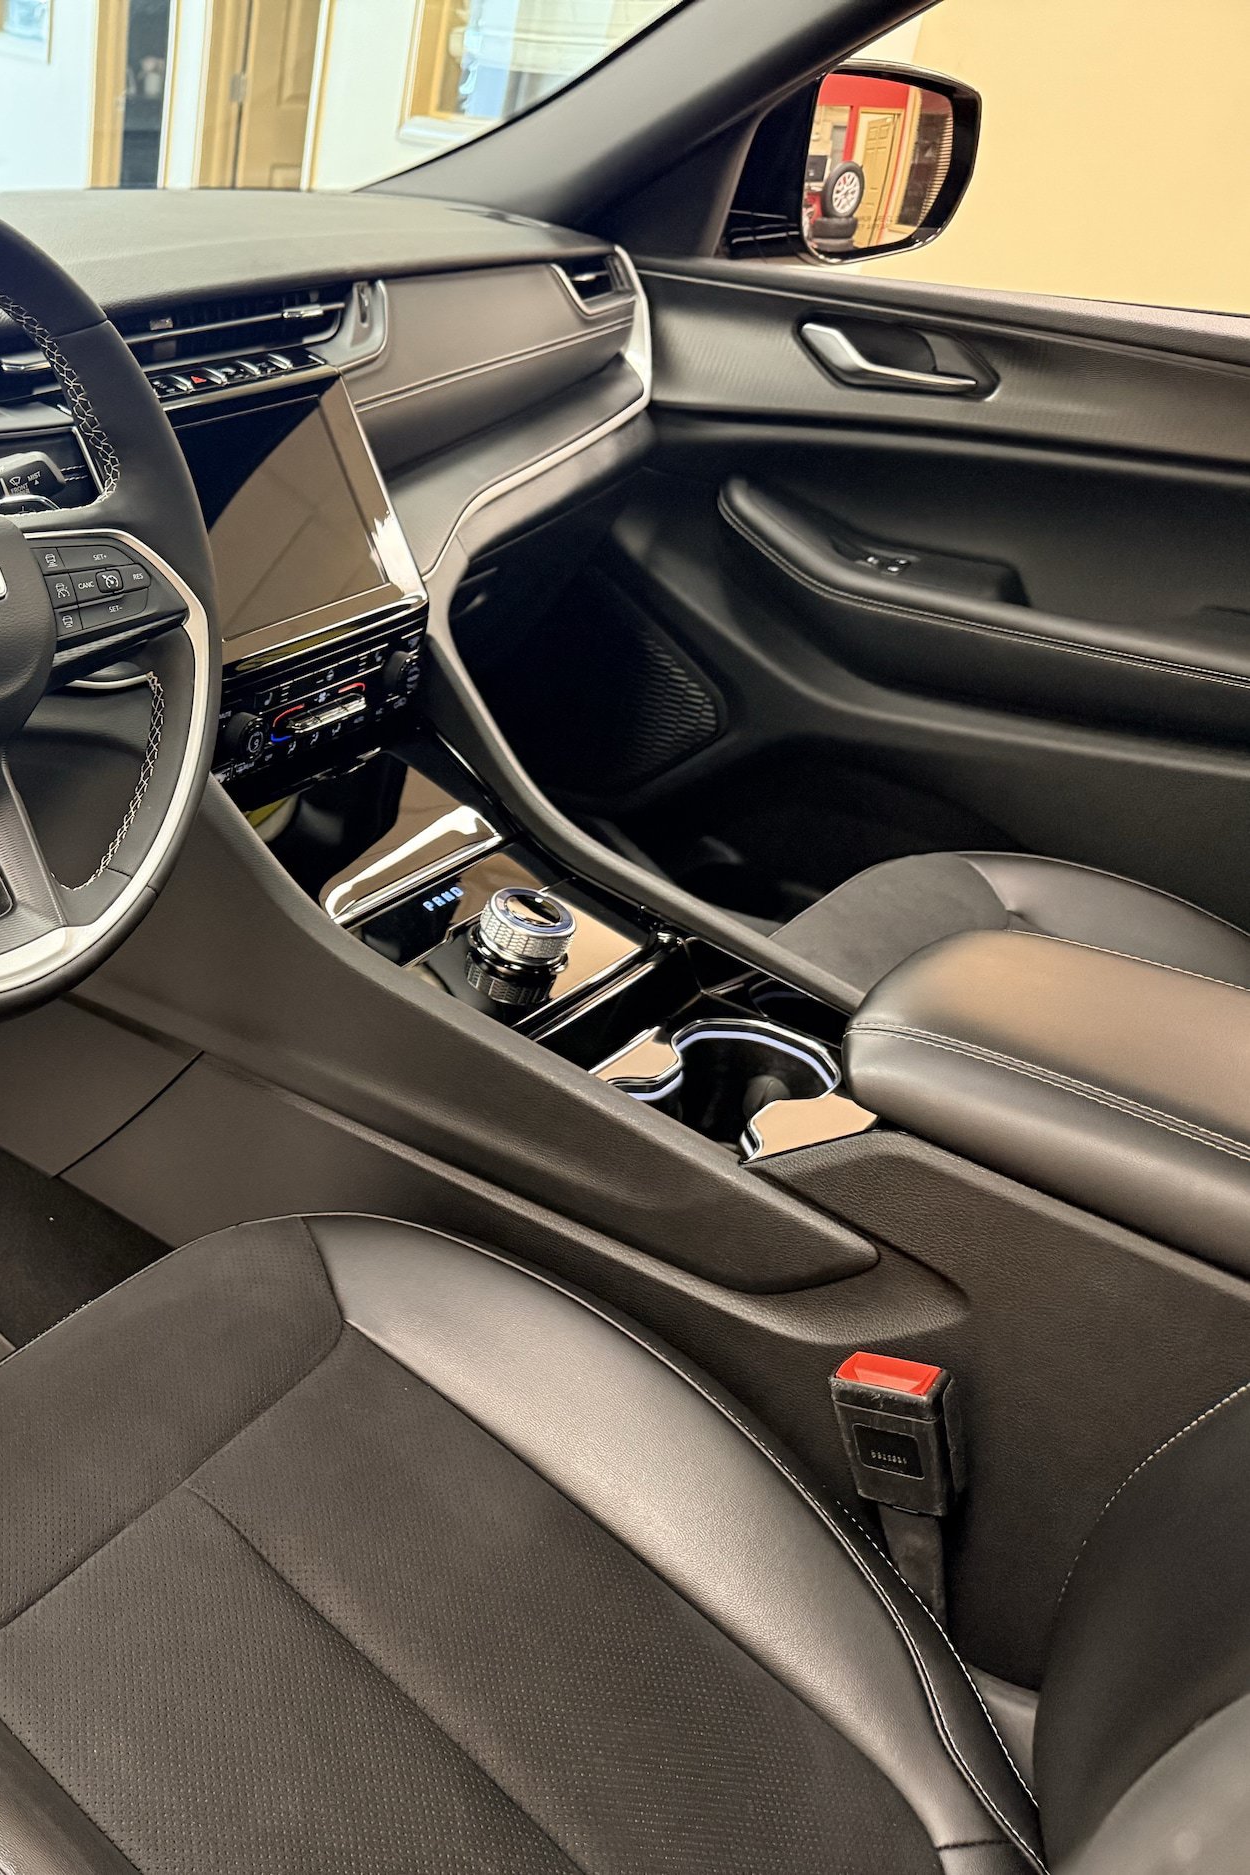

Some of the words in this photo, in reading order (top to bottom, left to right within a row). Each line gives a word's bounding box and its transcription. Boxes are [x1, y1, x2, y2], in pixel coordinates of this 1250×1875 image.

[26, 470, 42, 482] MIST
[10, 482, 29, 495] FRONT
[132, 572, 144, 581] RES
[77, 580, 96, 590] CANC
